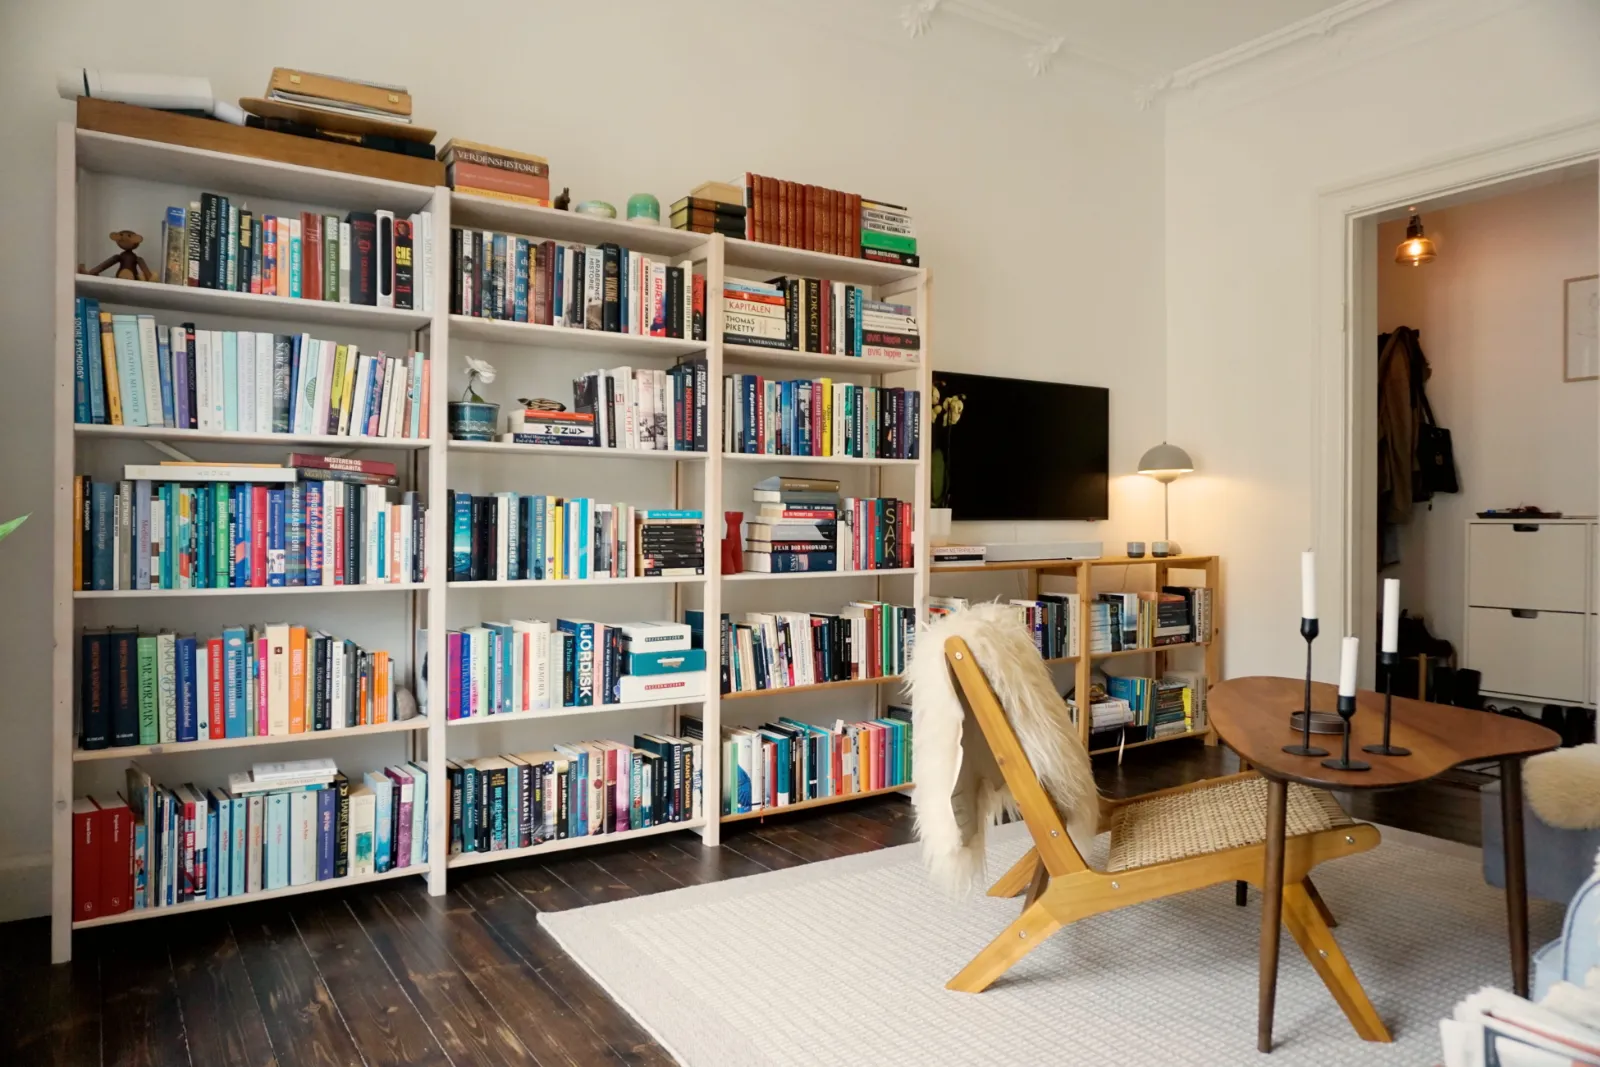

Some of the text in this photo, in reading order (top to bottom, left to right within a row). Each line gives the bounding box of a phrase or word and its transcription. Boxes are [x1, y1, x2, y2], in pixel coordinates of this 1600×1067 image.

[457, 150, 541, 174] VERDENSHISTORIE
[605, 276, 618, 302] VIKING
[726, 315, 755, 324] THOMAS
[729, 301, 771, 313] KAPITALEN
[726, 323, 755, 332] PIKETTY
[75, 317, 85, 380] SOCIAL PSYCHOLOGY
[130, 378, 139, 413] METODER
[310, 487, 319, 516] METODER
[291, 487, 301, 552] VIDENSKABSTEORI
[579, 631, 592, 698] JORDISK
[228, 687, 236, 718] TESTAMENTE
[633, 759, 641, 801] DAN BROWN
[453, 789, 461, 820] REYKJAVIK
[340, 798, 349, 854] HARRY POTTER
